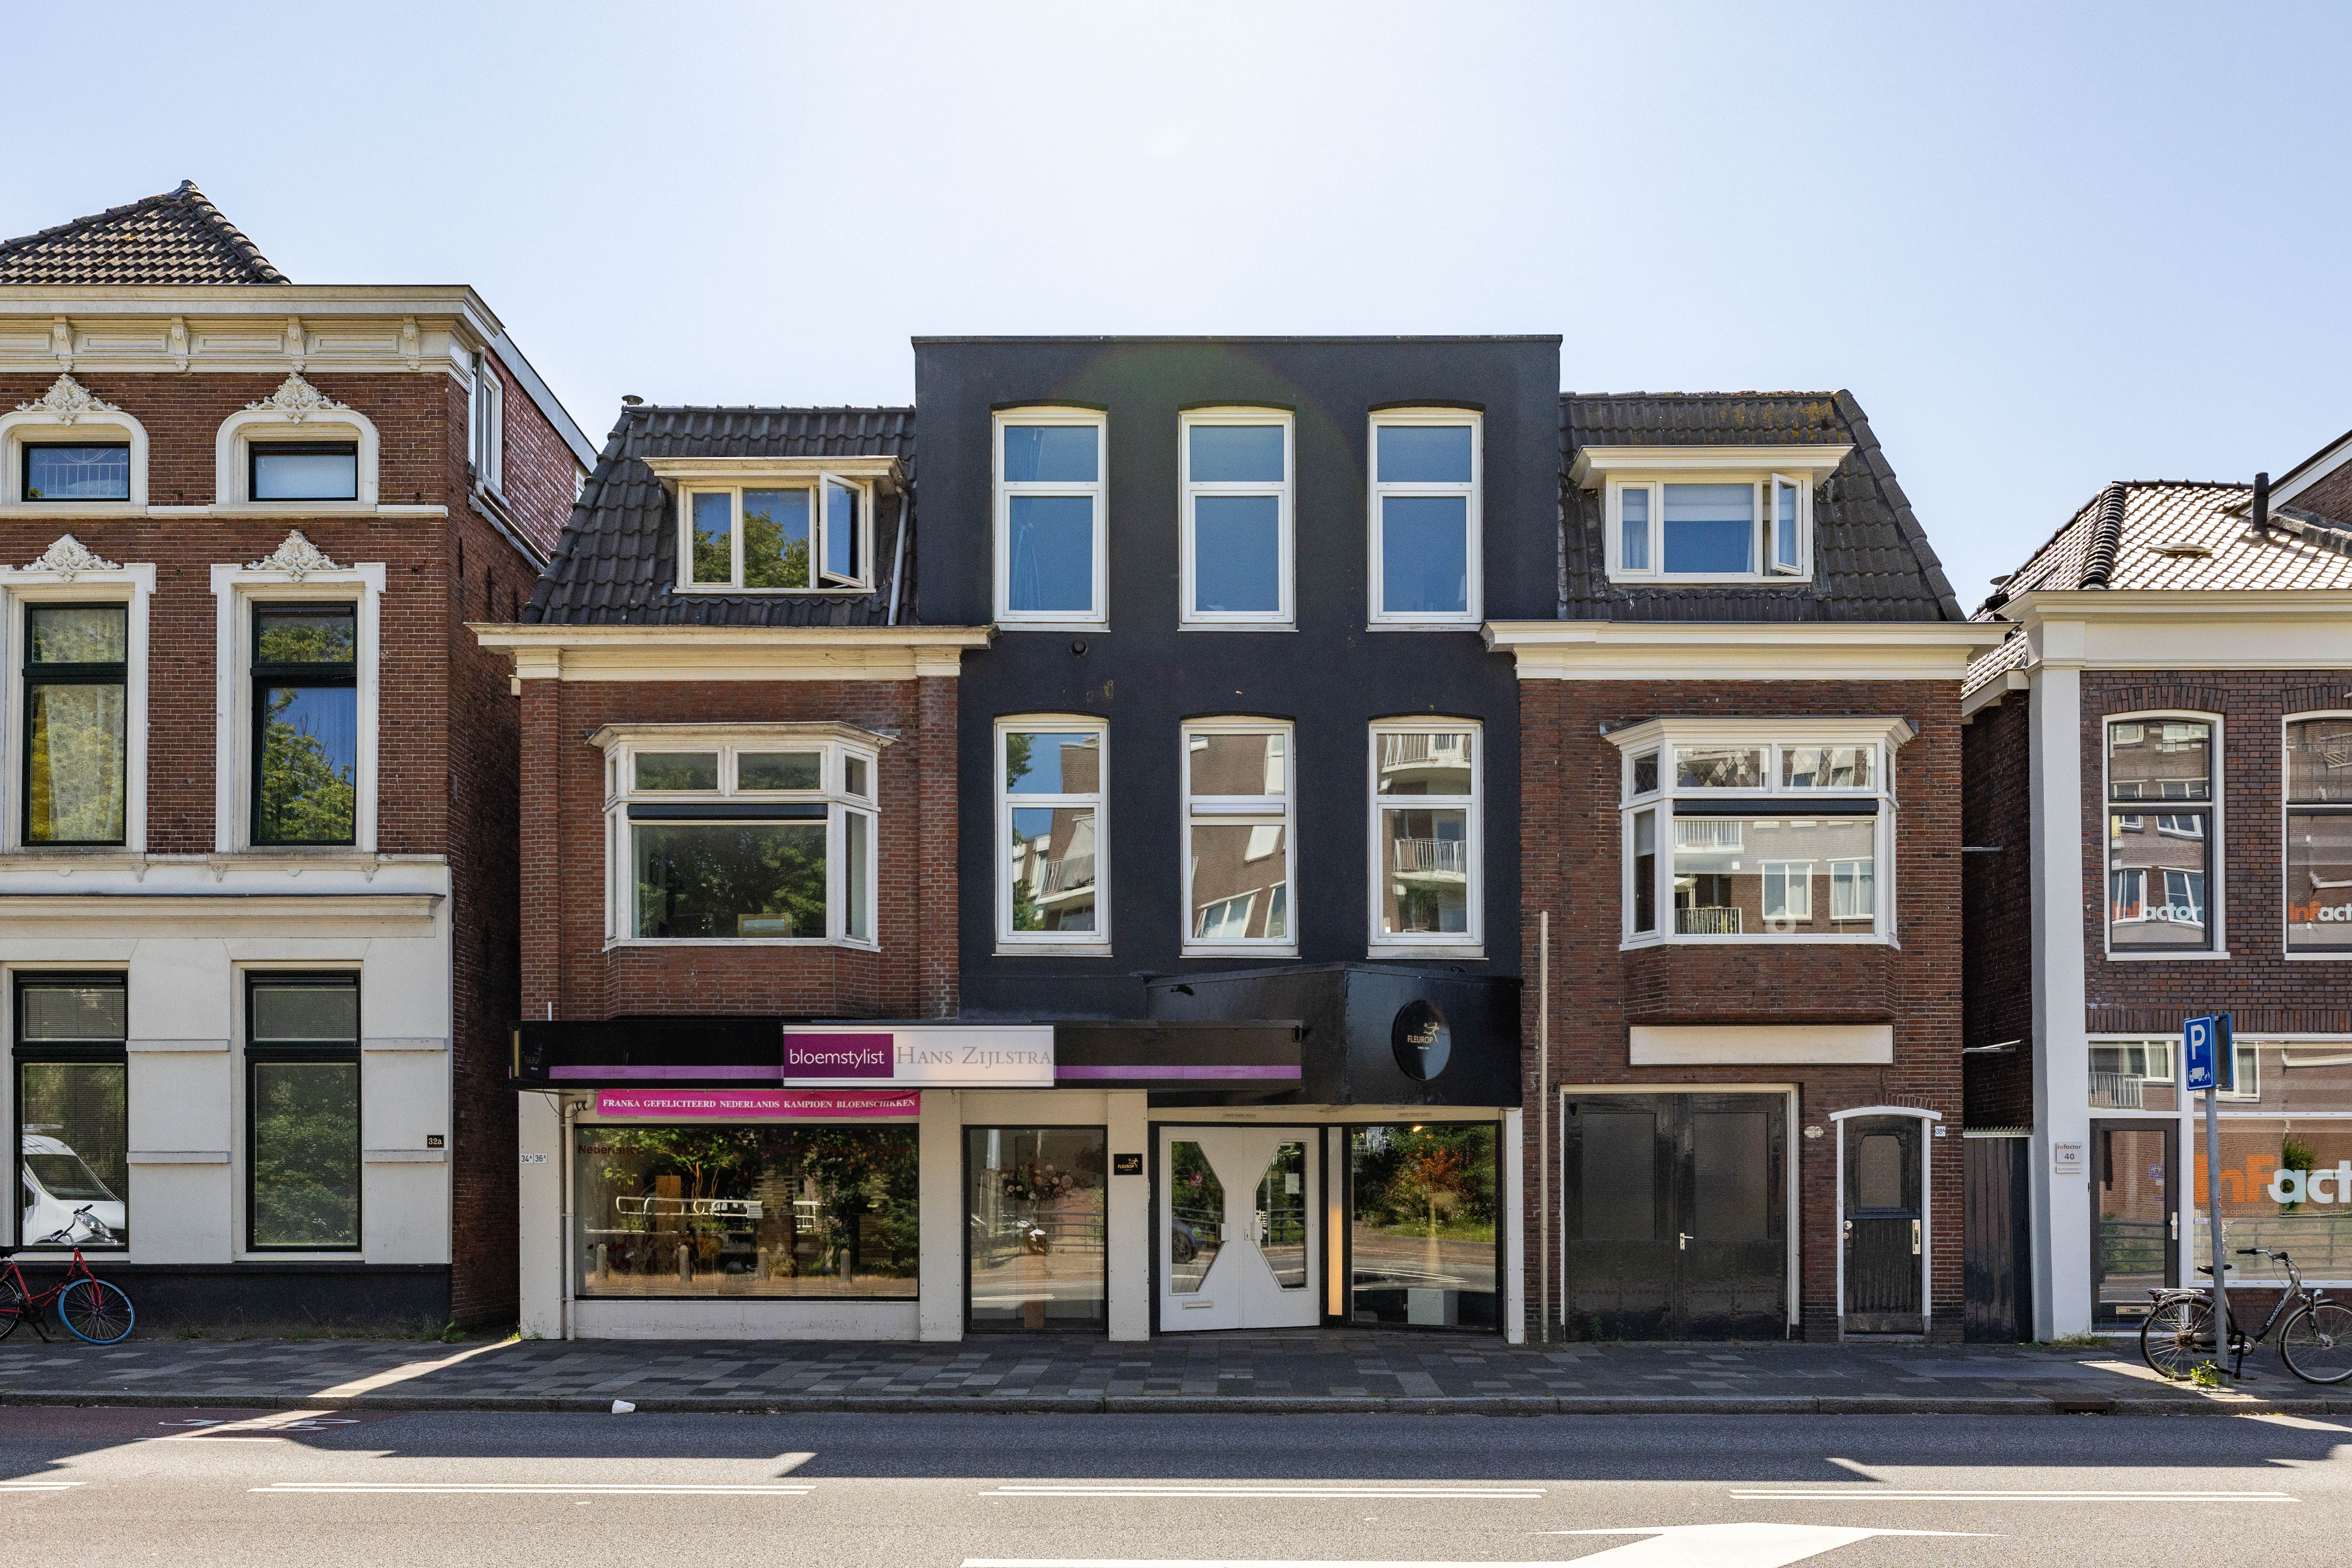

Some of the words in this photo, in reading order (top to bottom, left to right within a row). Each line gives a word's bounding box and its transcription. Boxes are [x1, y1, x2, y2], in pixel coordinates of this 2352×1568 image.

[2112, 901, 2202, 921] InFactor
[1408, 1035, 1433, 1044] FLEUROP
[2191, 1024, 2205, 1060] P
[790, 1049, 885, 1068] bloemstylist
[896, 1046, 953, 1064] HANS
[962, 1046, 1052, 1068] ZIJLSTRA
[837, 1099, 915, 1108] BLOEMSCHIKKEN
[2266, 1299, 2283, 1325] Gazelle
